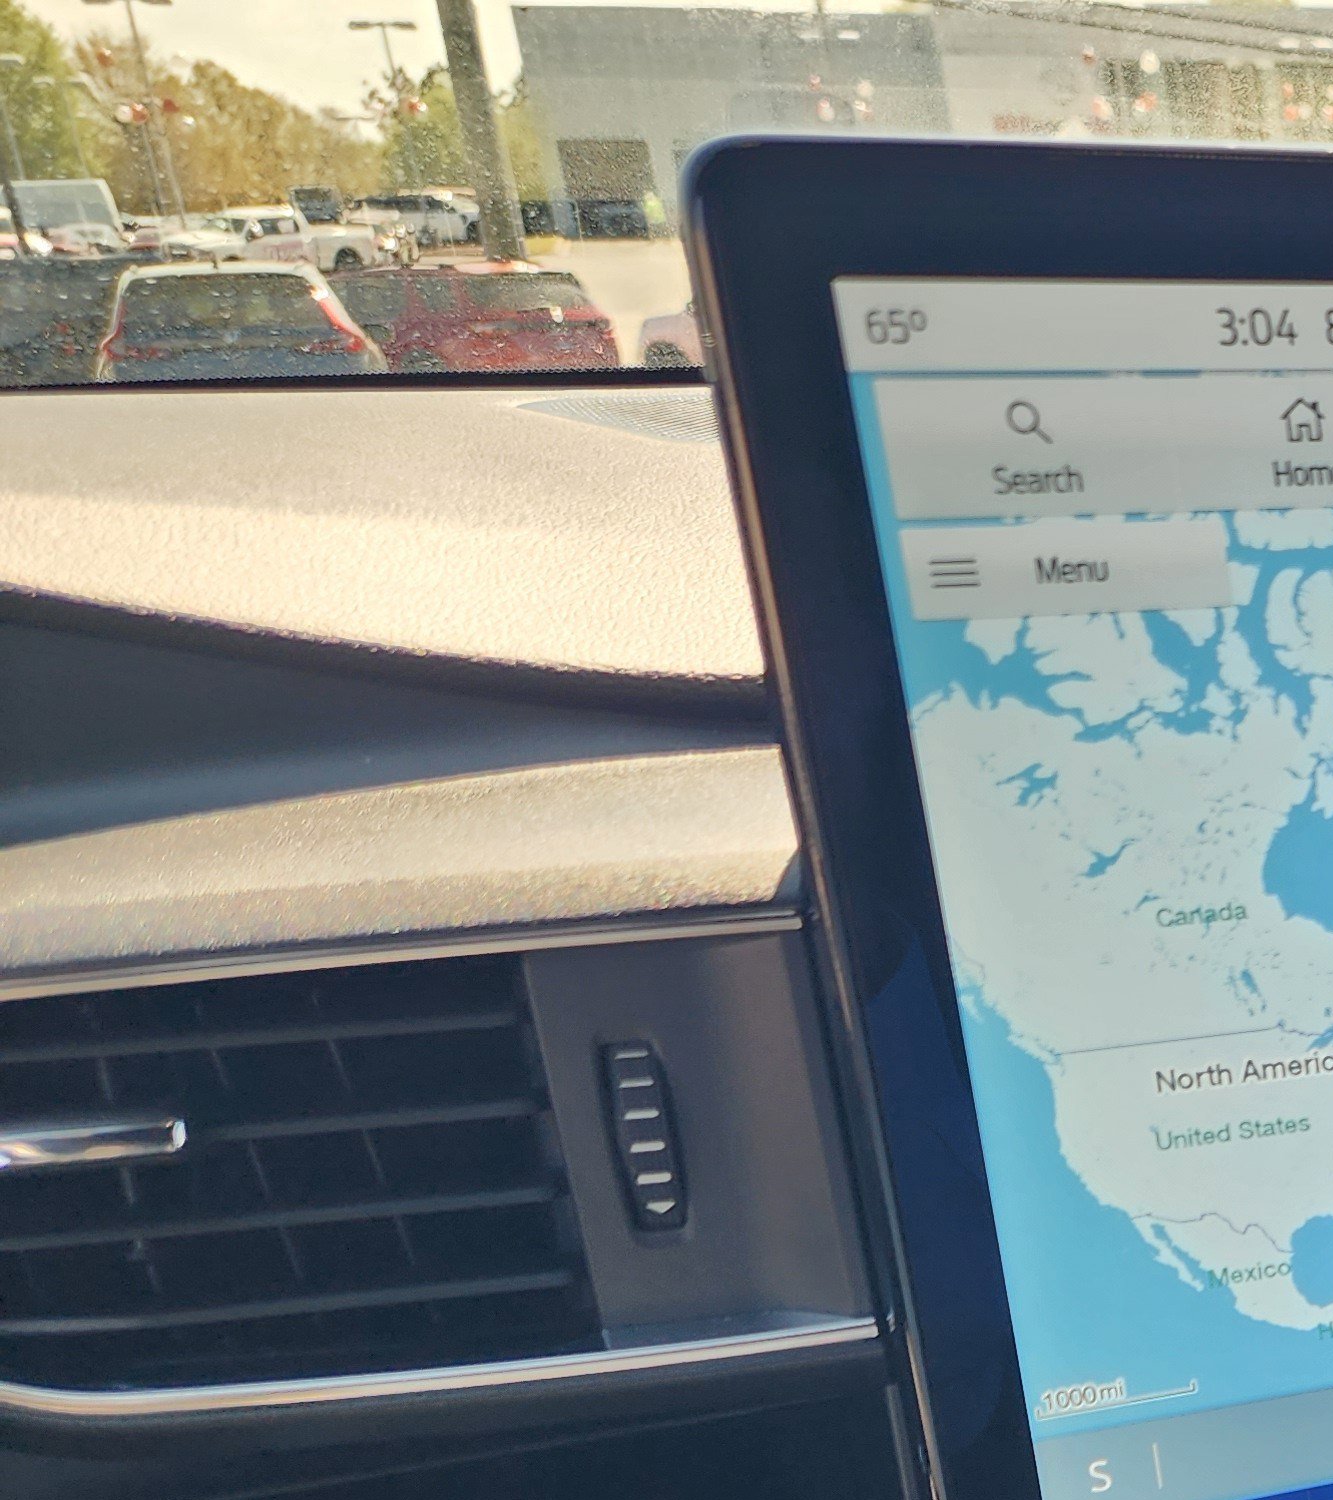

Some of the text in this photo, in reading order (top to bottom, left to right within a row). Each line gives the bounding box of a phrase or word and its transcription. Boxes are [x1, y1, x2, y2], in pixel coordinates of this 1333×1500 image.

[1215, 307, 1299, 347] 3:04
[991, 464, 1085, 495] Search
[1033, 556, 1110, 584] Menu
[1155, 902, 1249, 928] Canada
[1154, 1063, 1233, 1093] North
[1155, 1116, 1312, 1151] United States
[1207, 1260, 1293, 1288] Mexico
[1088, 1458, 1113, 1493] S
